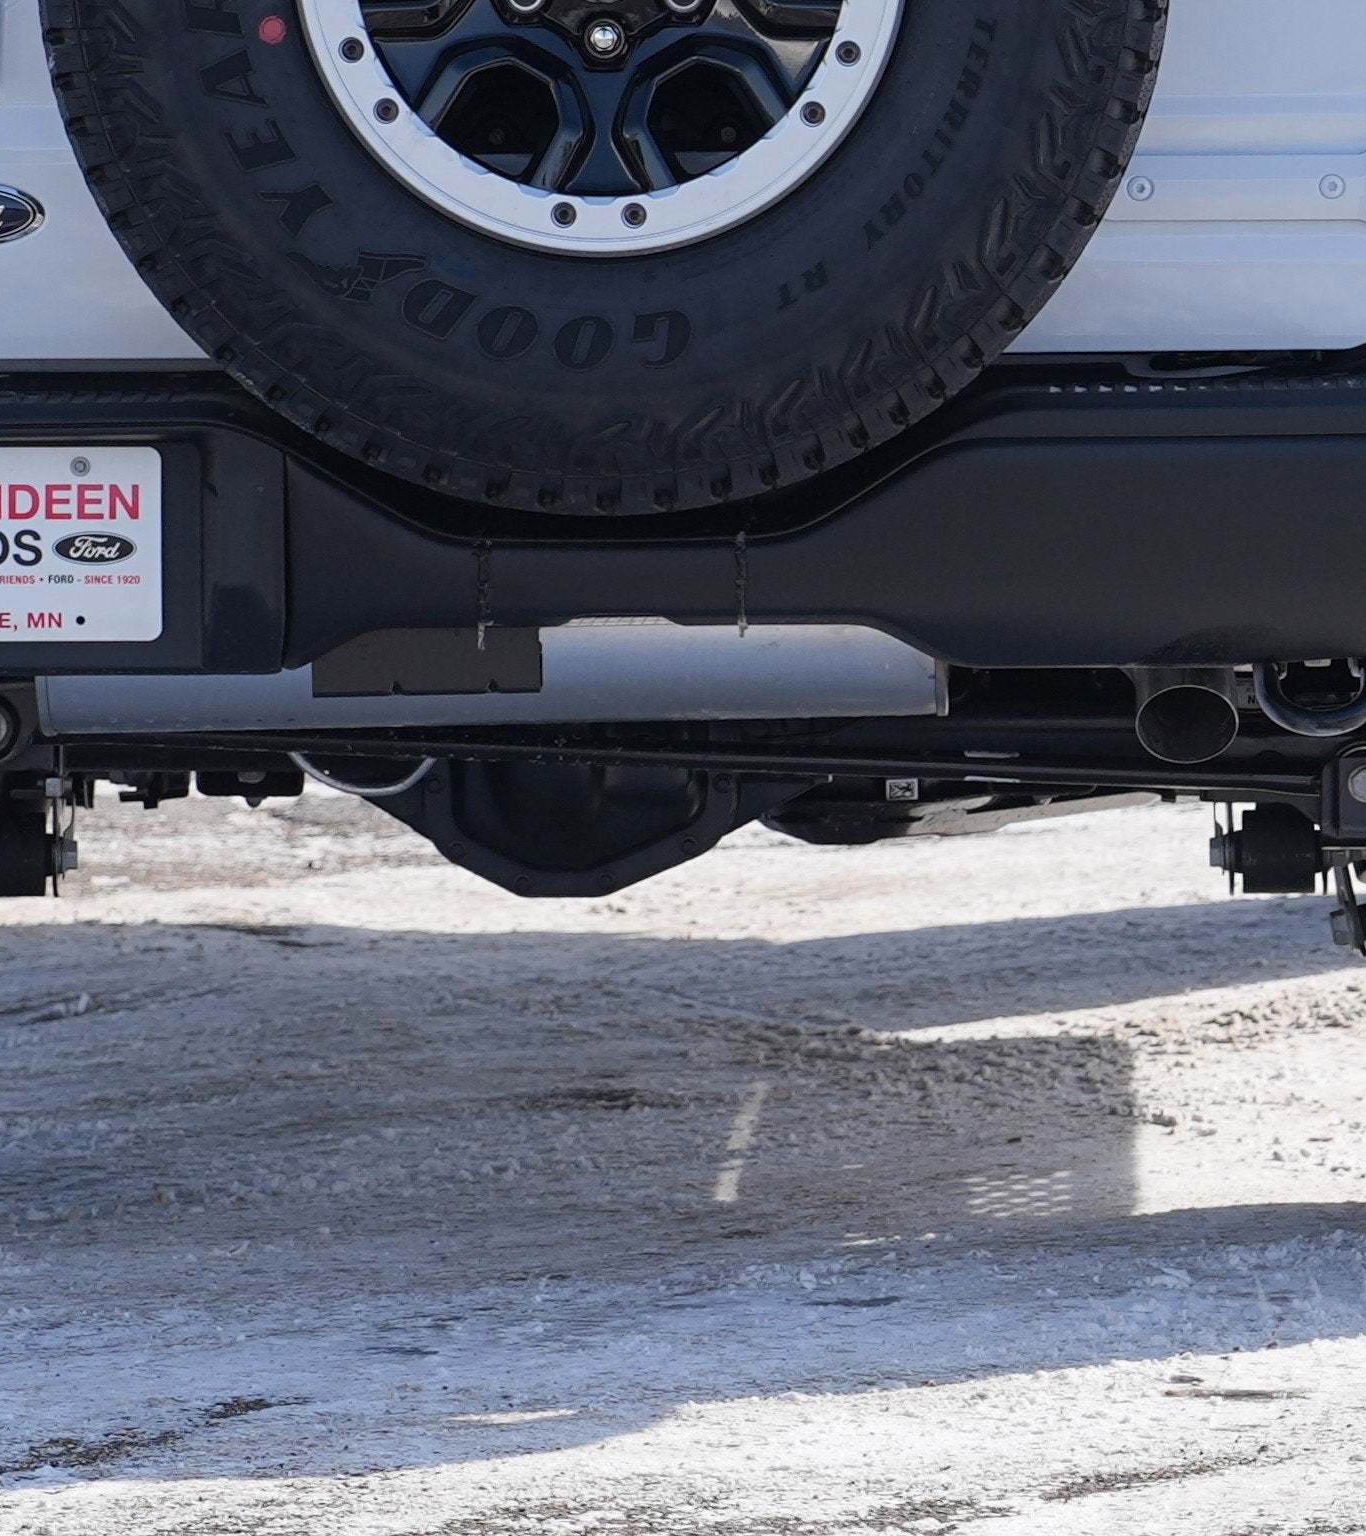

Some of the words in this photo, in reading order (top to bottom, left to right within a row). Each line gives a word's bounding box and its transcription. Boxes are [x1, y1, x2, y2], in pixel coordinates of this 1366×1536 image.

[865, 17, 999, 251] TERRITORY
[775, 260, 831, 311] RT
[68, 535, 121, 559] Ford
[47, 574, 75, 585] FORD
[84, 574, 114, 585] SINCE
[116, 574, 141, 585] 1920
[26, 612, 64, 629] MN
